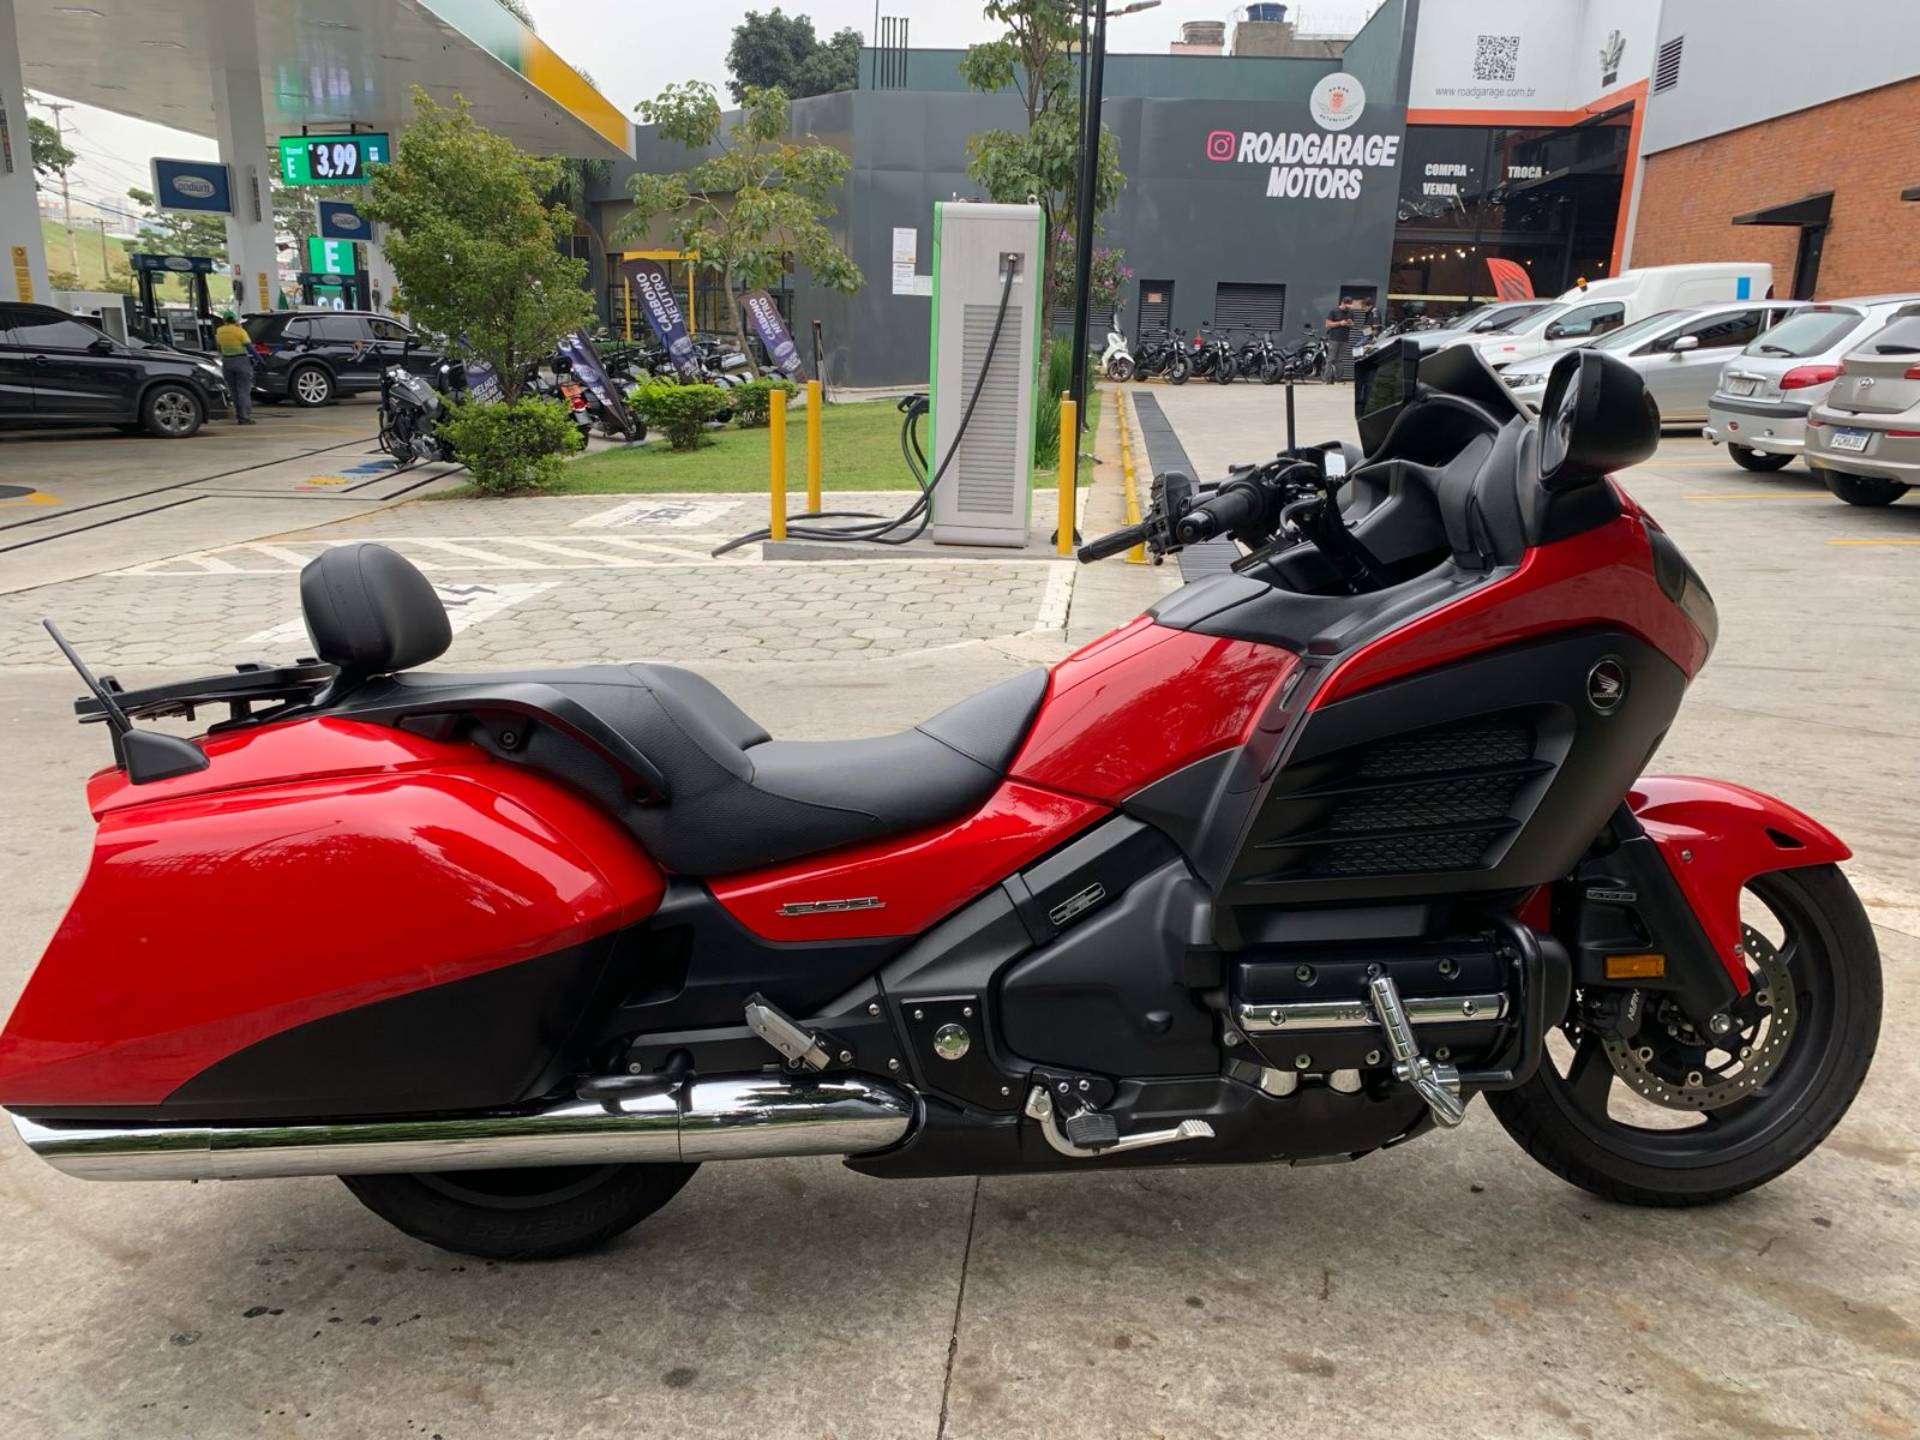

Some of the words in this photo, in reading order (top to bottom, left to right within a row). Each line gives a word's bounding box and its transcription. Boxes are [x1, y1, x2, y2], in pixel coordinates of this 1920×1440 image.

[1435, 86, 1536, 99] www.roadgarage.com.br
[316, 143, 357, 178] 3,99
[1237, 131, 1400, 167] ROADGARAGE
[286, 156, 297, 178] E
[1265, 166, 1363, 200] MOTORS
[1424, 163, 1468, 177] COMPRA
[1507, 165, 1543, 179] TROCA
[1422, 182, 1458, 196] VENDA
[324, 240, 341, 273] E
[636, 272, 673, 332] CARBONO
[649, 272, 682, 324] NEUTRO
[749, 298, 776, 341] CARBONO
[759, 296, 784, 335] NEUTRO
